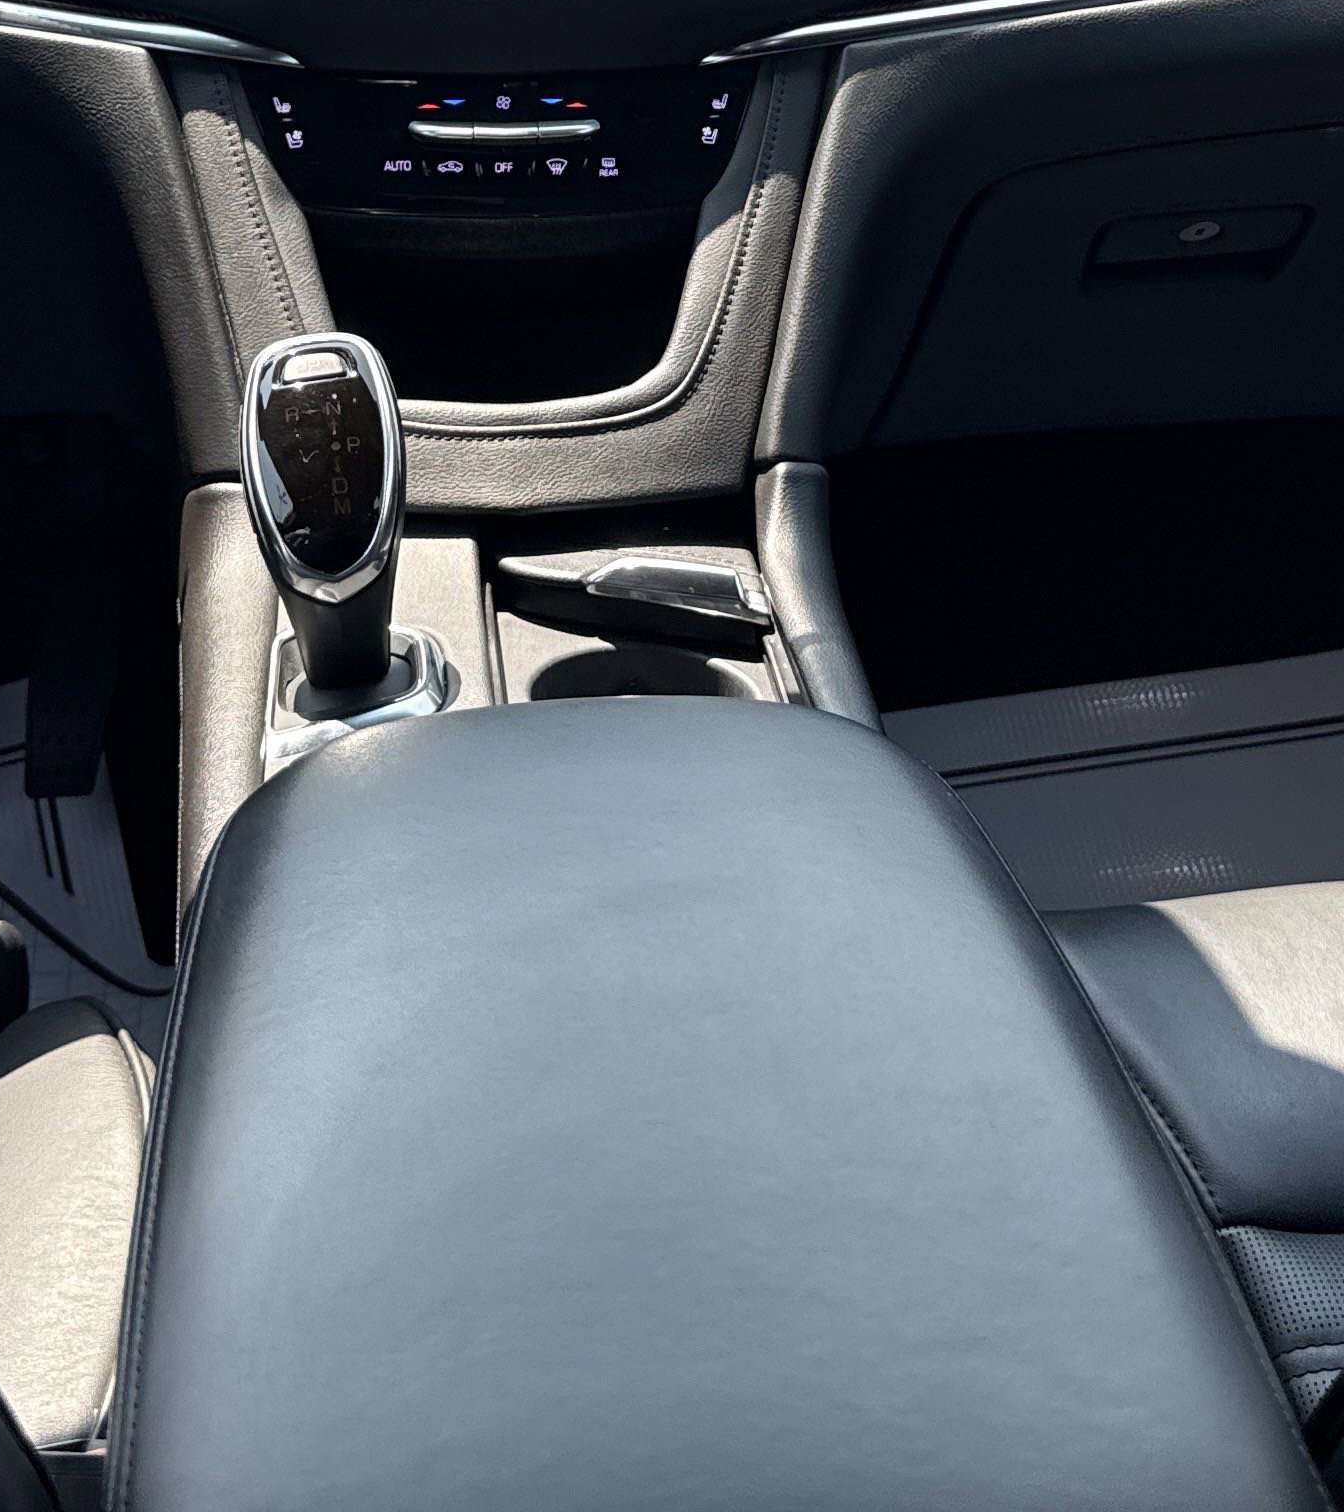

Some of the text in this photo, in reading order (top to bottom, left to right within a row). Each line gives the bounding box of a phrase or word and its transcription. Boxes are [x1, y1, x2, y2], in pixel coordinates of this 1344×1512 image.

[383, 159, 514, 173] AUTO OFF
[598, 168, 619, 177] REAR
[285, 399, 343, 424] R N
[346, 436, 361, 455] P
[332, 476, 349, 495] D
[333, 497, 352, 516] M
